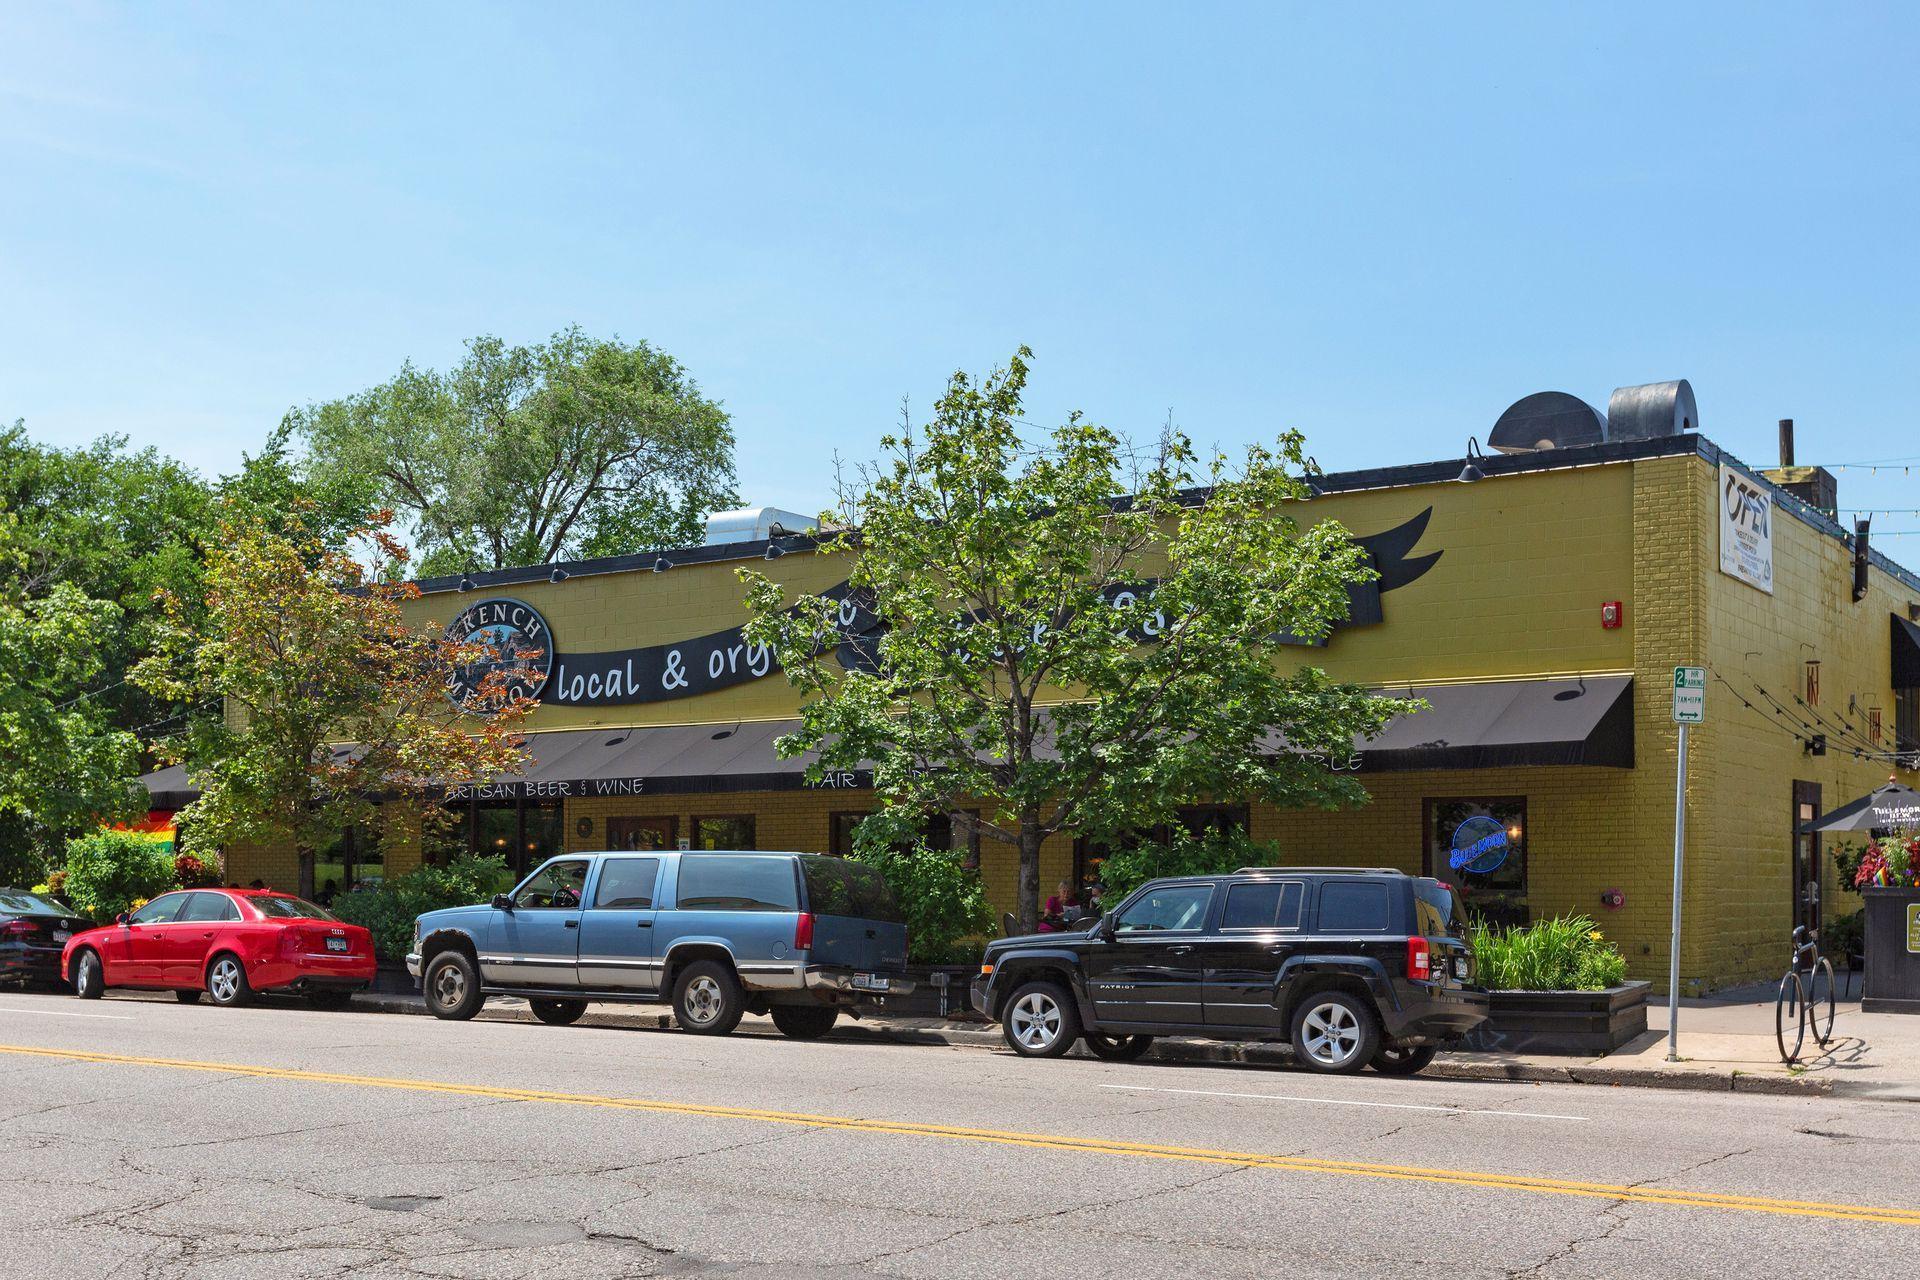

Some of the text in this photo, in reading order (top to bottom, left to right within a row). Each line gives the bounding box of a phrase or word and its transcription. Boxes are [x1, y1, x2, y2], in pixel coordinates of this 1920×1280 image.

[1725, 474, 1769, 539] OPEN
[443, 604, 541, 641] RENCH
[557, 659, 640, 701] local
[661, 649, 689, 690] &
[1677, 671, 1683, 685] 2
[448, 784, 516, 799] ARTISAN
[524, 781, 572, 797] BEER
[596, 778, 644, 795] WINE
